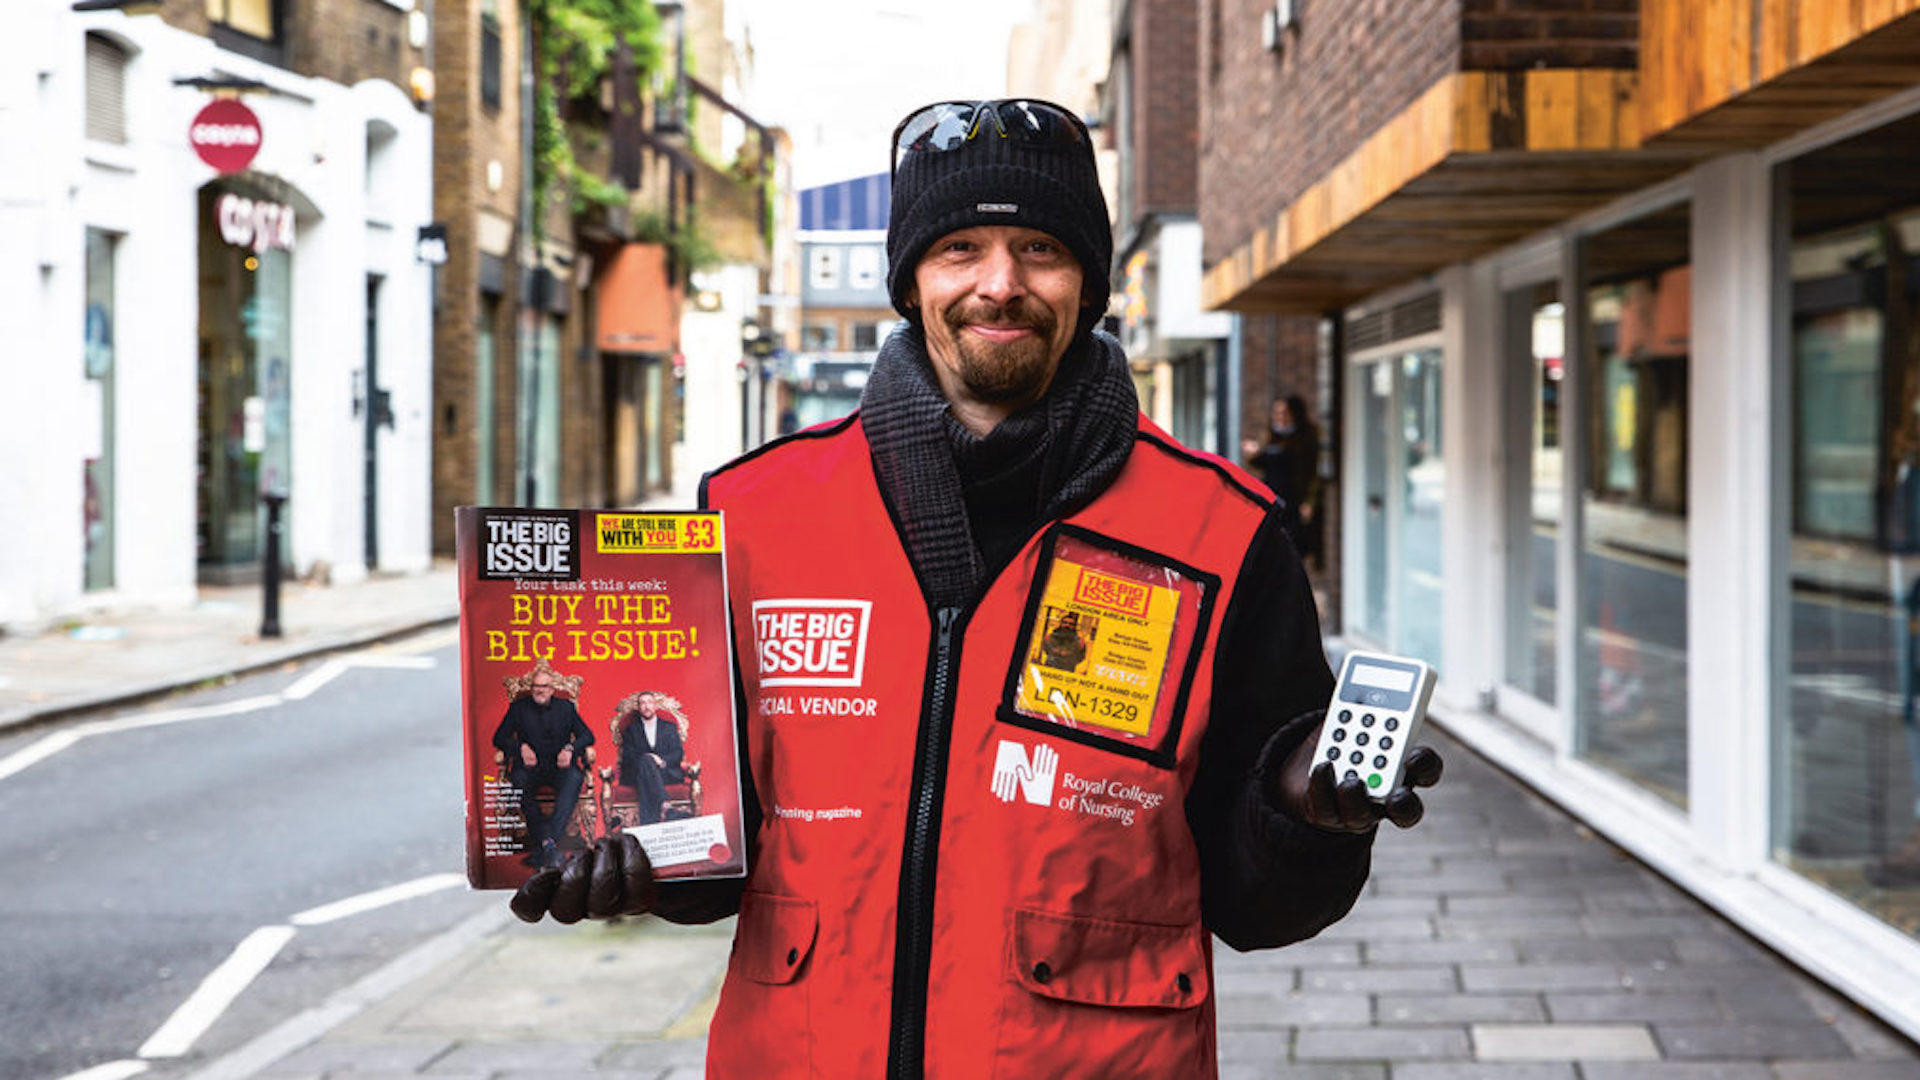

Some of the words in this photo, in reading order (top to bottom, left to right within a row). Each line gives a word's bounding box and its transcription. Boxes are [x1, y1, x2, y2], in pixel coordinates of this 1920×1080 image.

[486, 521, 532, 543] THE
[533, 522, 571, 545] BIG
[602, 518, 619, 529] WE
[682, 519, 715, 549] £3
[602, 530, 643, 546] WITH
[646, 530, 677, 542] YOU
[486, 543, 571, 573] ISSUE
[514, 577, 549, 591] Your
[553, 578, 586, 591] task
[590, 578, 624, 591] this
[627, 578, 668, 591] week:
[1088, 575, 1117, 591] THE
[1118, 583, 1145, 599] BIG
[509, 594, 584, 625] BUY
[595, 594, 672, 625] THE
[1083, 585, 1143, 611] ISSUE
[758, 613, 806, 639] THE
[807, 613, 854, 639] BIG
[485, 630, 556, 661] BIG
[566, 626, 700, 662] ISSUE!
[759, 639, 852, 673] ISSUE
[1079, 680, 1097, 688] NOT
[1131, 690, 1150, 701] OUT
[800, 697, 877, 716] VENDOR
[1062, 773, 1106, 797] Royal
[1108, 780, 1163, 809] College
[1058, 795, 1077, 811] of
[1079, 799, 1136, 826] Nursing
